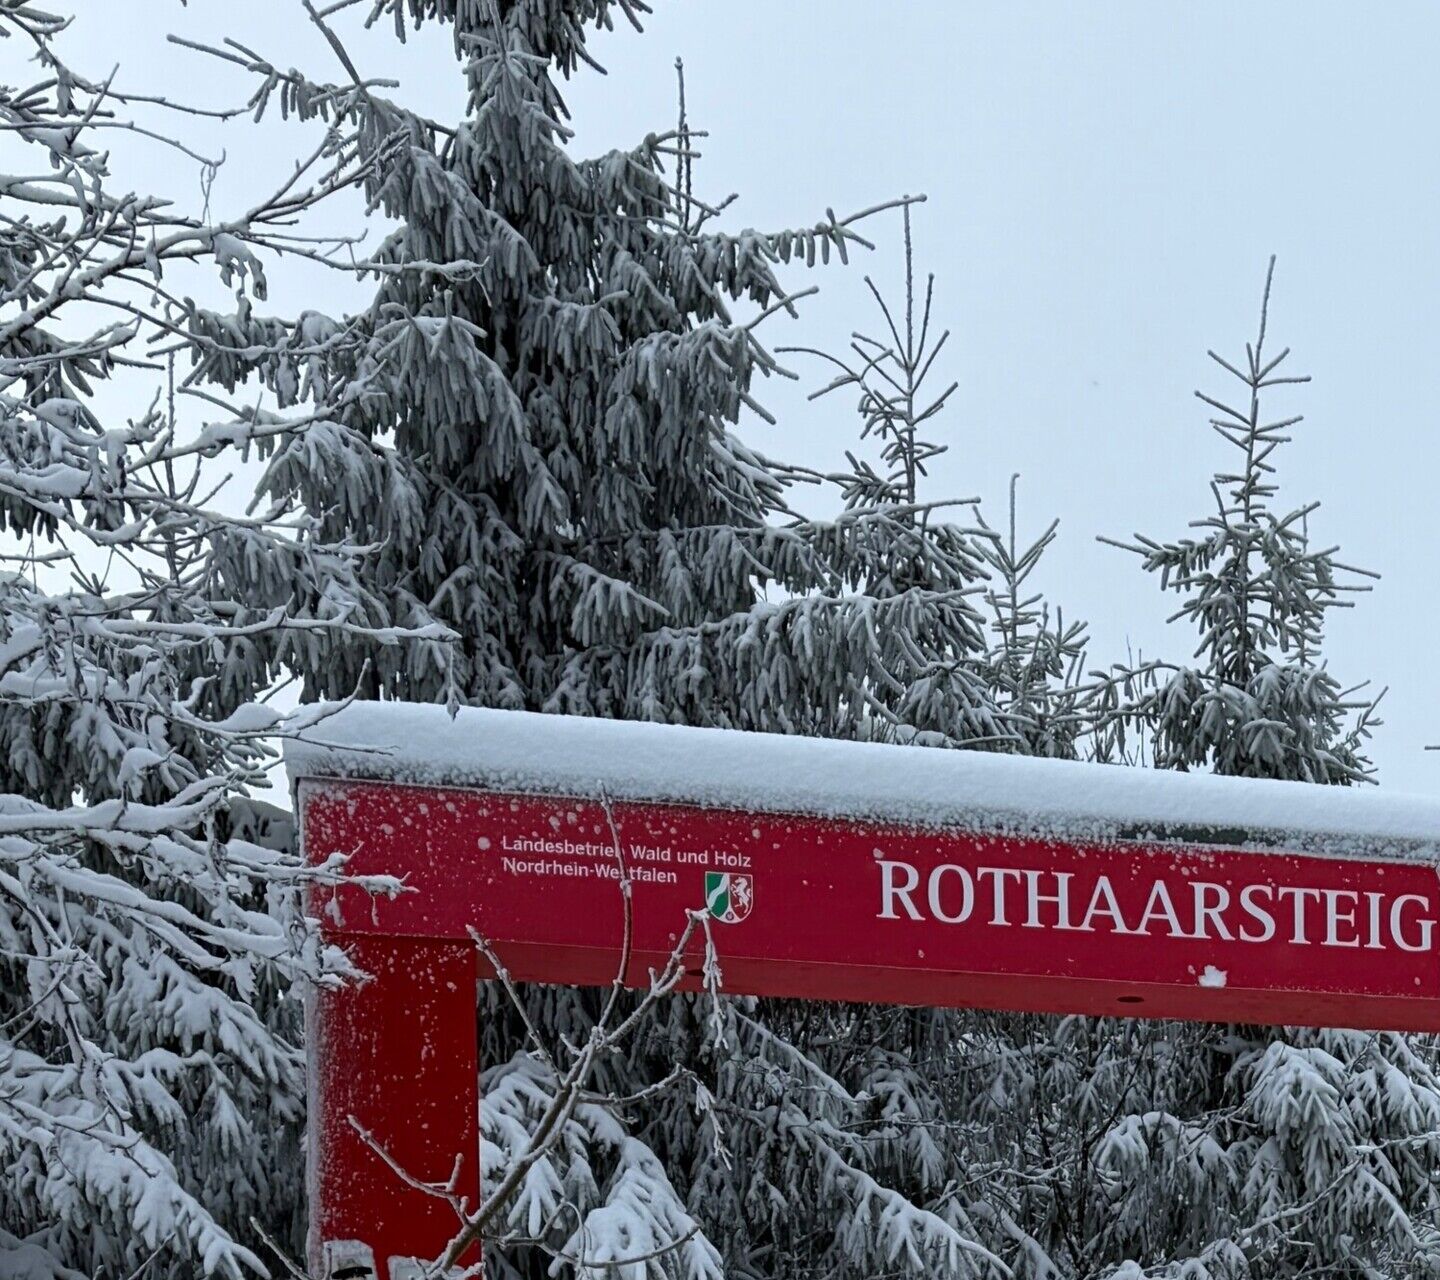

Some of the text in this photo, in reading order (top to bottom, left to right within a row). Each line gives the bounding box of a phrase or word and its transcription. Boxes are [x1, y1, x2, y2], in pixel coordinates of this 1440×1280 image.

[502, 836, 752, 867] Landesbetrie Wald und Holz
[502, 857, 677, 883] Nordrhein-Wetfalen
[874, 858, 1437, 954] ROTHAARSTEIG
